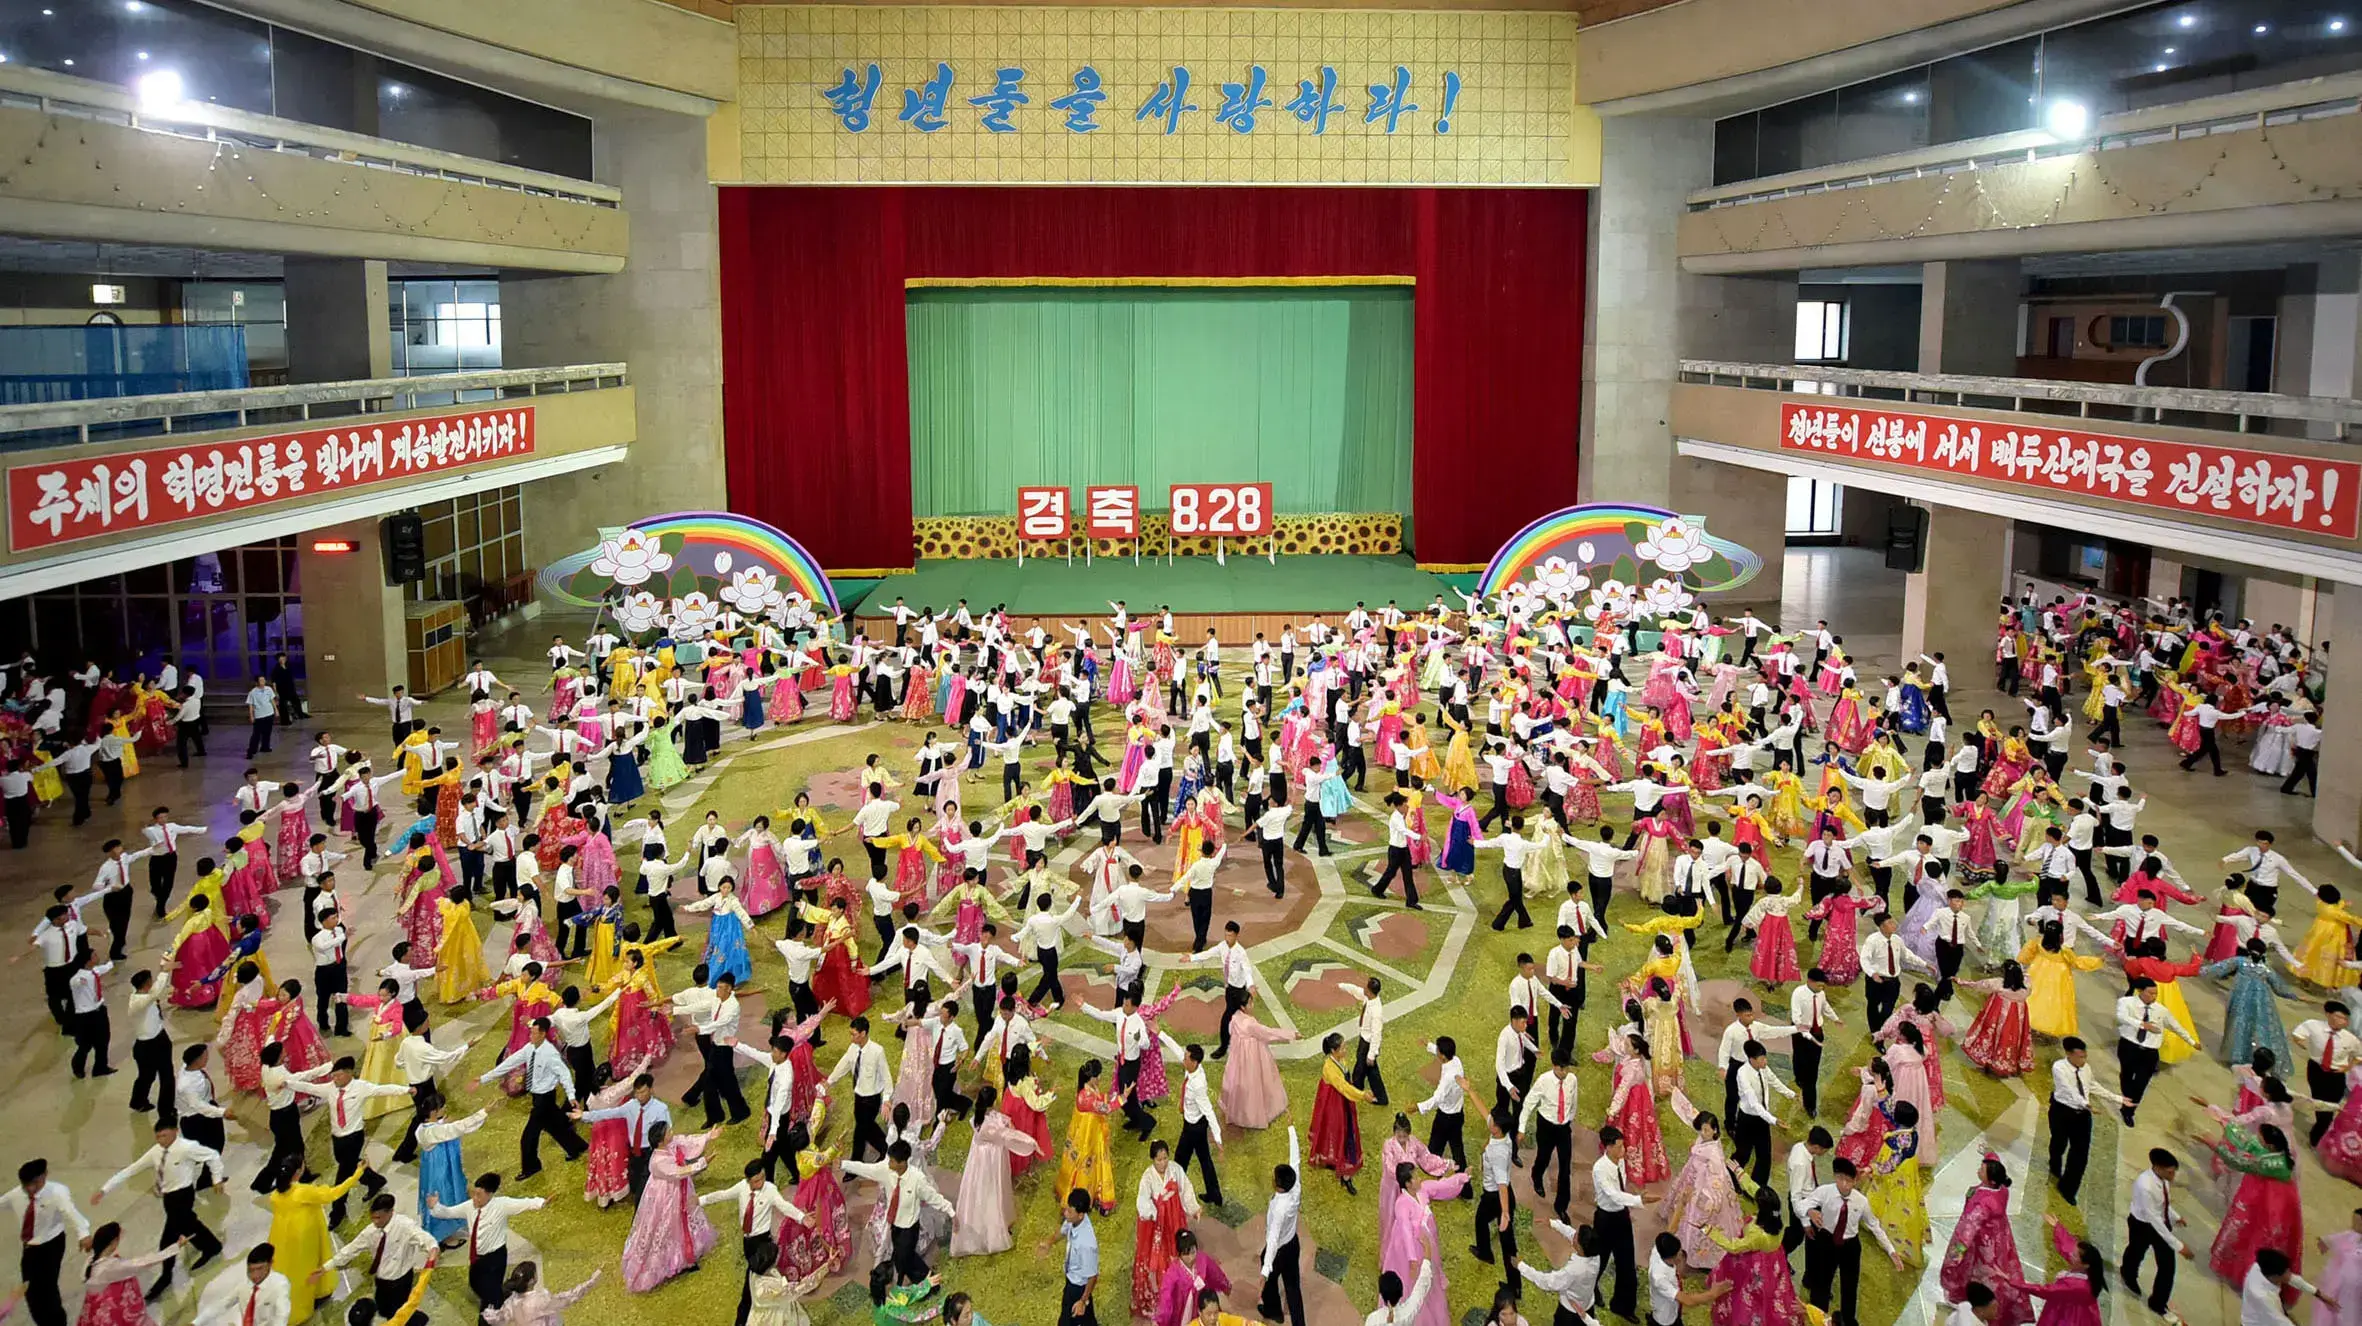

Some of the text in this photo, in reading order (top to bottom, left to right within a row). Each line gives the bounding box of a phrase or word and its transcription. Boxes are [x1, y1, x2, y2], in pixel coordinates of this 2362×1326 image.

[822, 62, 1463, 136] 청년들을 사랑하라!
[29, 411, 527, 537] 주체의 혁명전통을 빛나게 계승발전시키자!
[1172, 486, 1262, 532] 8.28
[1787, 408, 2340, 528] 청년들이 선봉에 서서 백두산대국을 건설하자!
